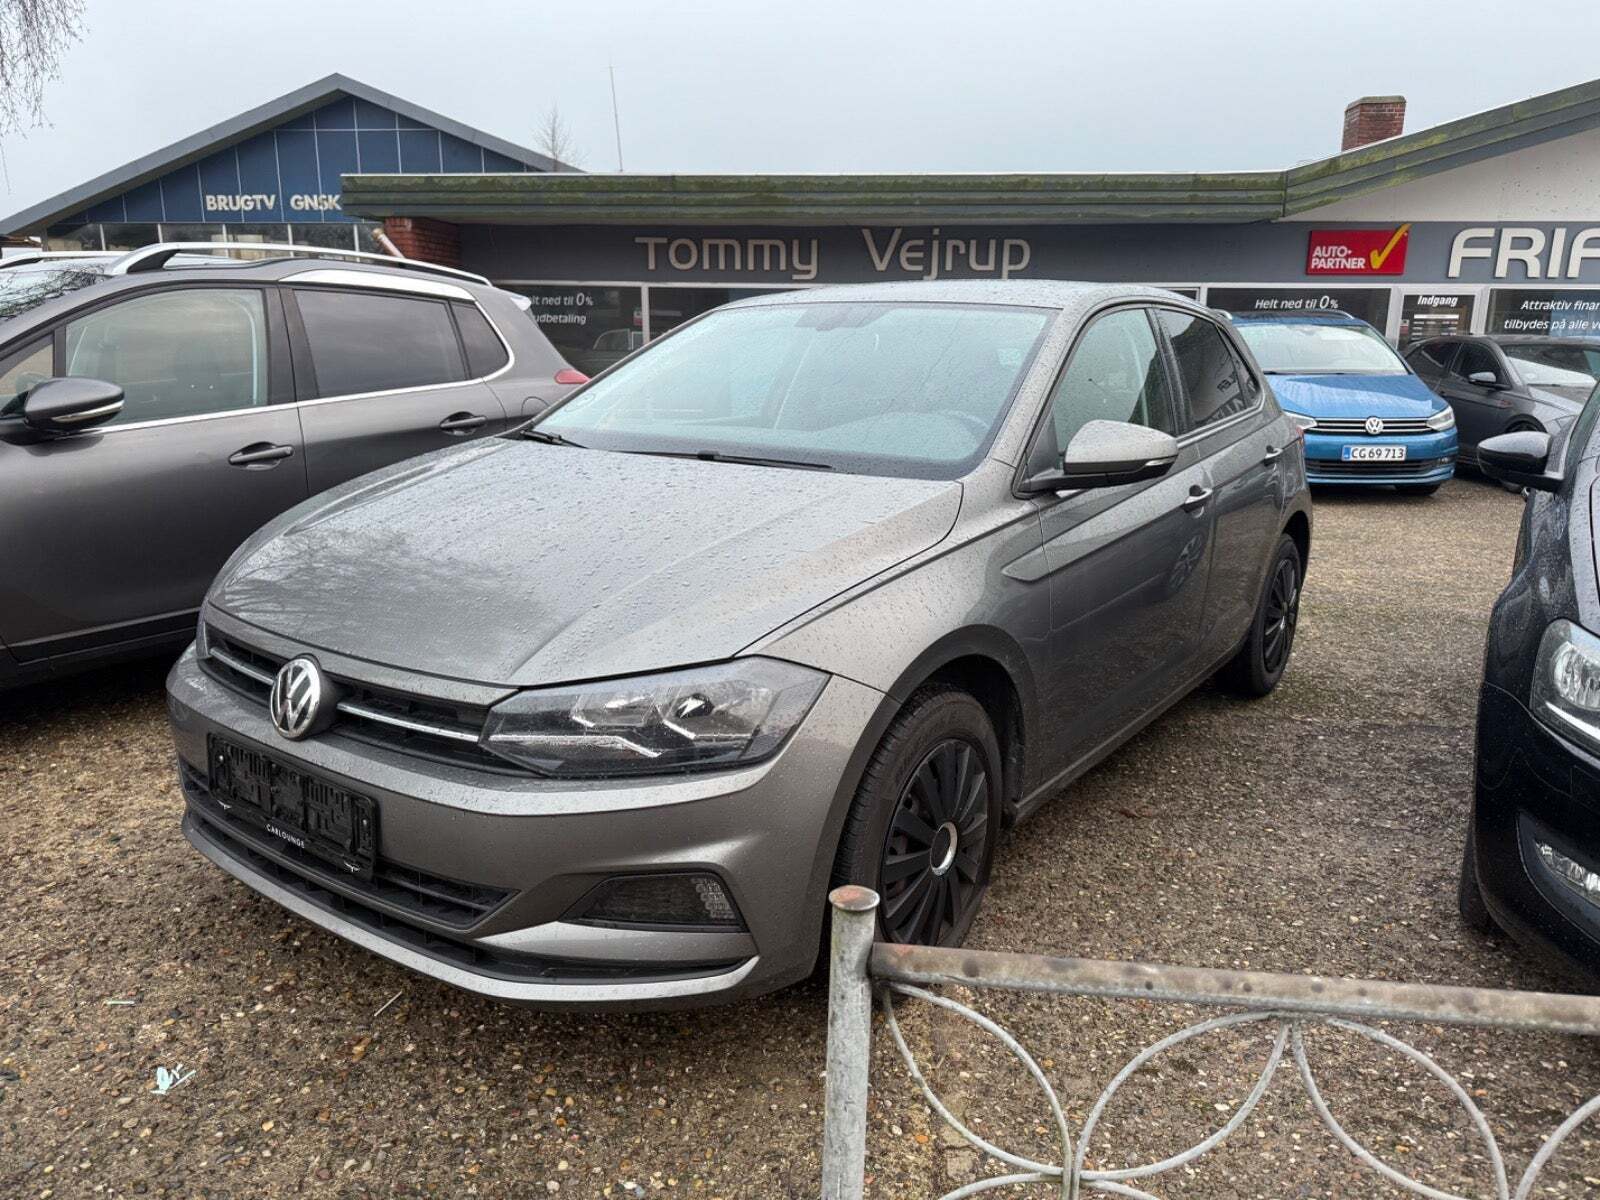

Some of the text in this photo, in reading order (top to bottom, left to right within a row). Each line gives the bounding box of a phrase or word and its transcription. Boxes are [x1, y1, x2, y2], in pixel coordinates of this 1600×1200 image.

[205, 194, 342, 211] BRUGTV GNSK
[635, 227, 1031, 280] Tommy Vejrup
[1311, 257, 1366, 269] PARTNER
[541, 295, 561, 306] ned
[563, 295, 574, 306] til
[1254, 299, 1279, 309] Helt
[1280, 299, 1303, 309] ned
[1305, 299, 1318, 309] til
[1417, 295, 1459, 308] Indgang
[1520, 300, 1572, 310] Attraktiv
[1503, 319, 1550, 331] tilbydes
[1550, 318, 1567, 331] på
[1568, 319, 1589, 330] alle
[1351, 448, 1404, 459] CG 69 713
